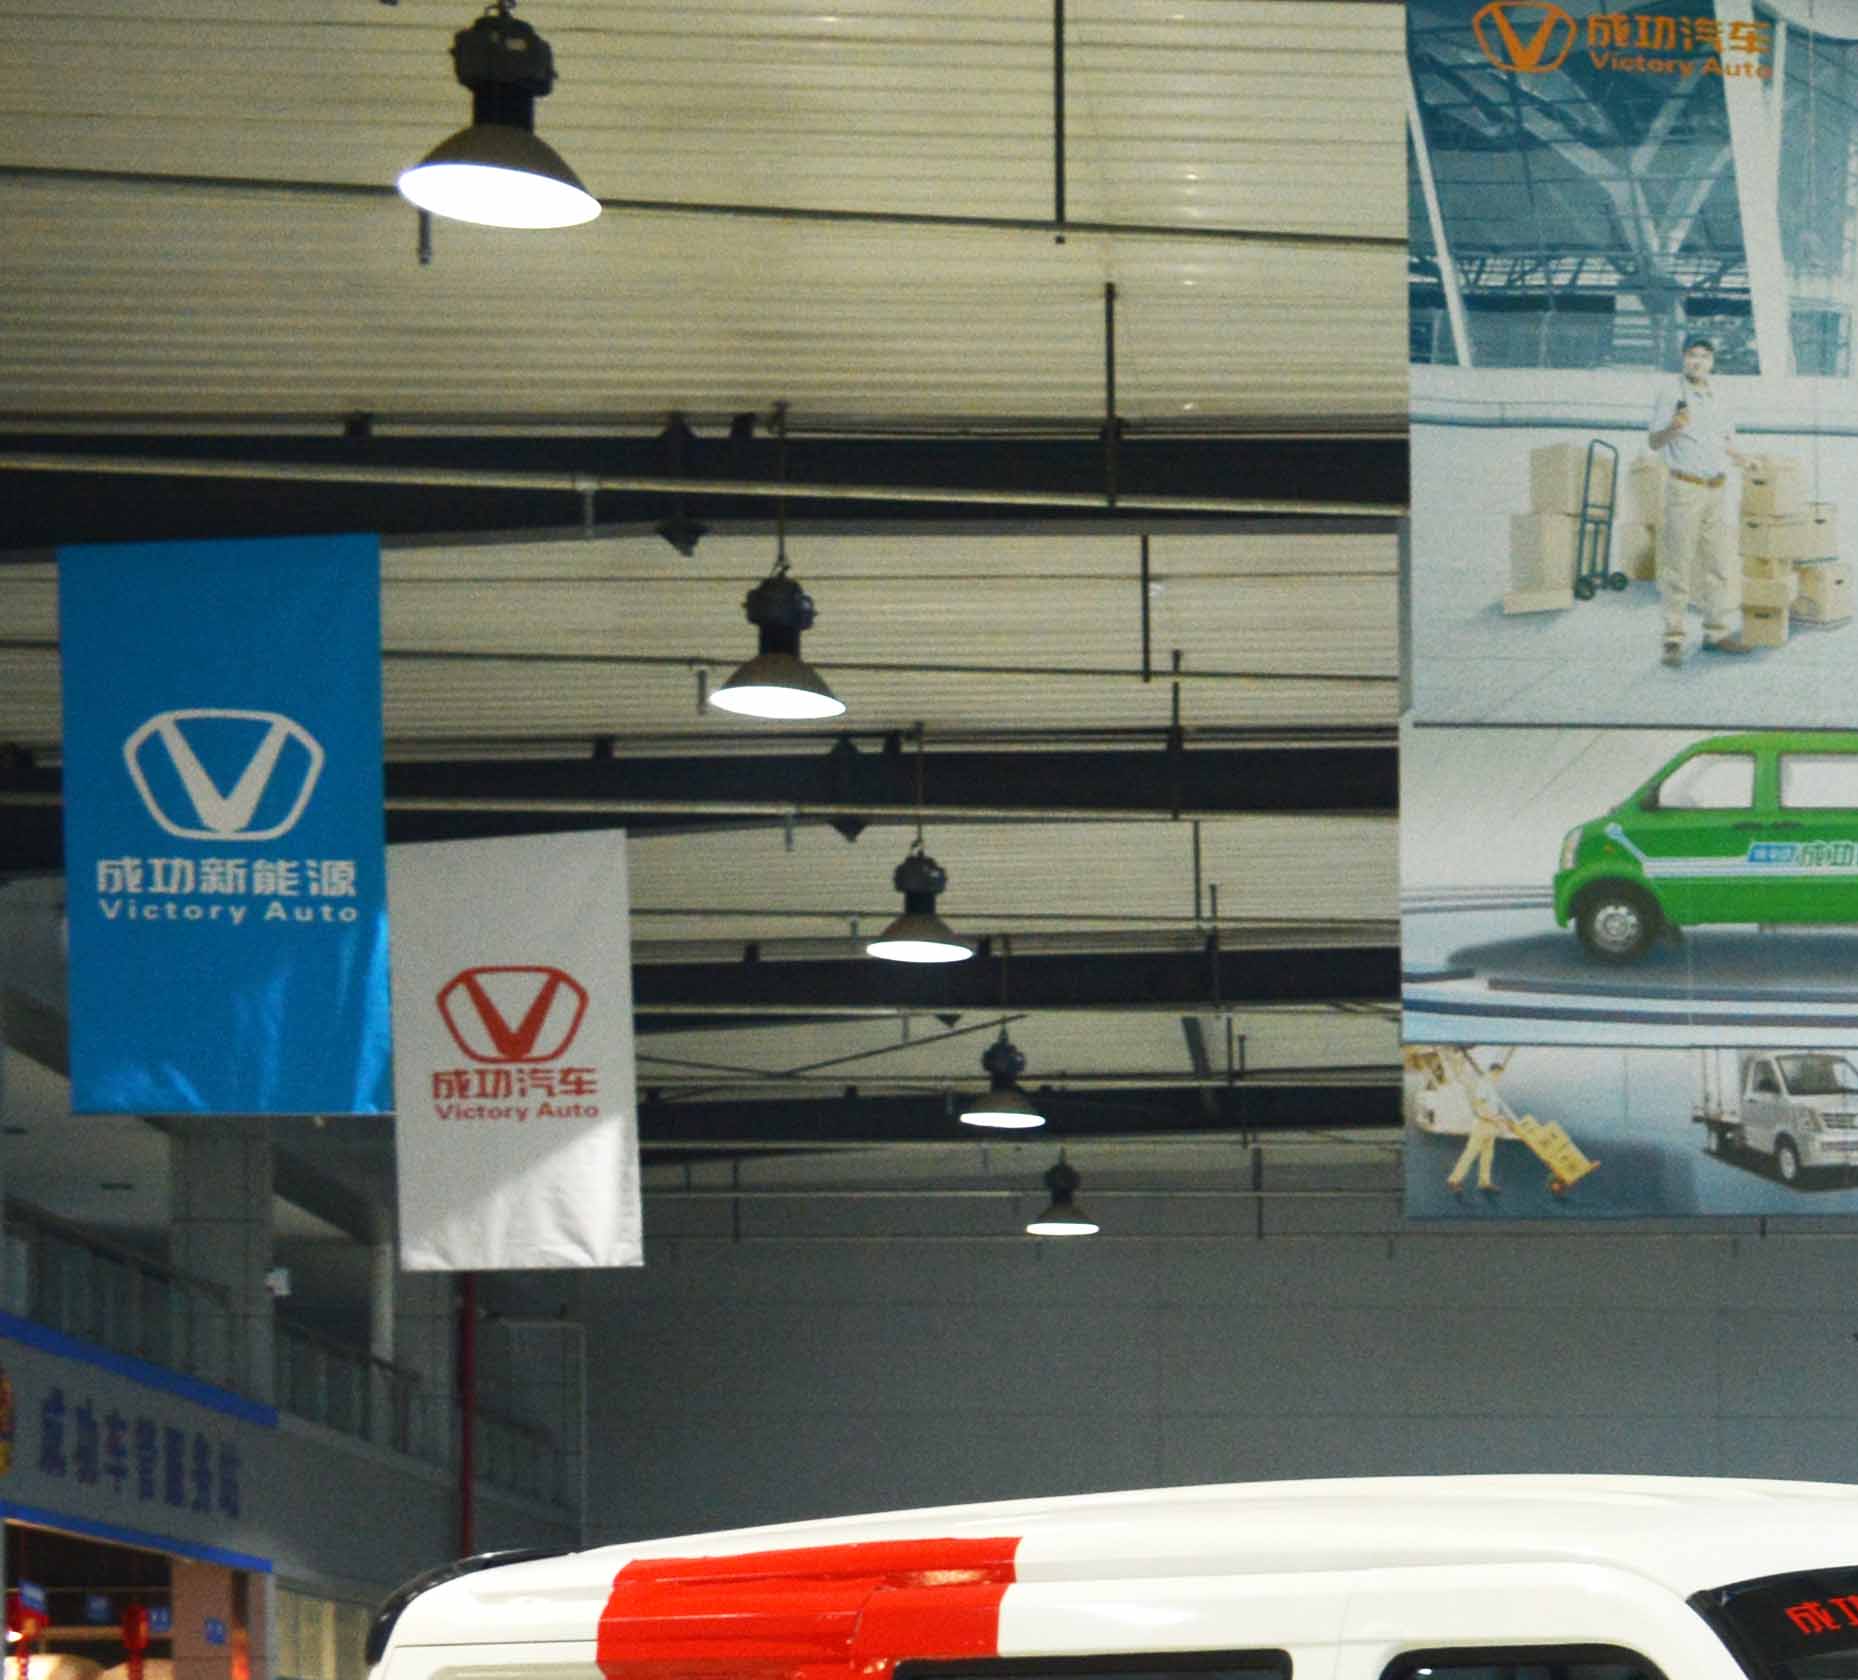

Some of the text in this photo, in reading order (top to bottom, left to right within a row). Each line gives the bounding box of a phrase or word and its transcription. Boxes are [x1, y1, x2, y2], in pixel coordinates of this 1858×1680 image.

[1586, 12, 1772, 54] 成功汽车
[1588, 50, 1772, 79] Victory Auto
[97, 857, 356, 897] 成功新能源
[99, 900, 358, 925] Victory Auto
[432, 1067, 598, 1099] 成功汽车
[434, 1102, 599, 1122] Victory Auto
